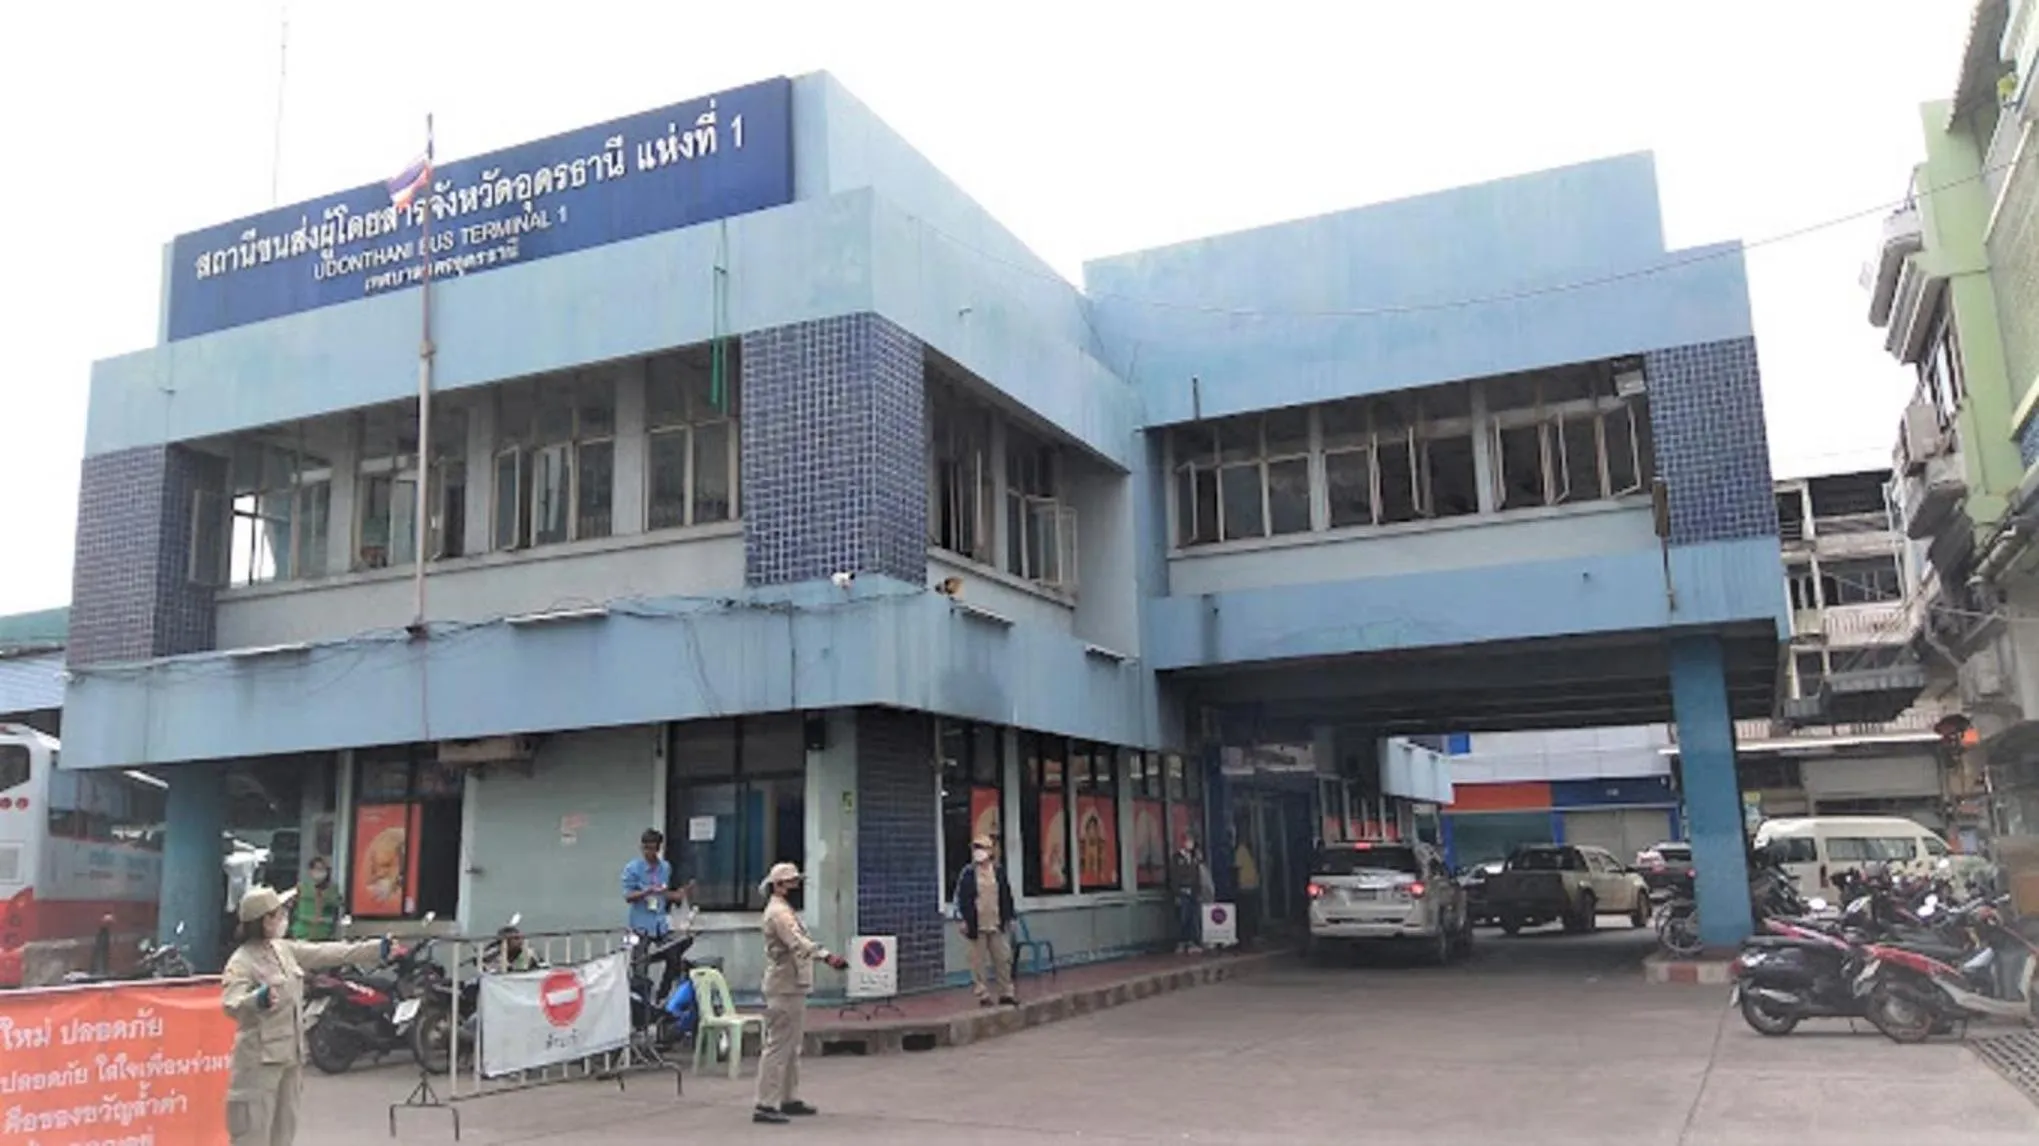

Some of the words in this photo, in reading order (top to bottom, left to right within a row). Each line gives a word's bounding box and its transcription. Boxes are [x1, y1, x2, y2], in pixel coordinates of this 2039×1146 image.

[636, 98, 718, 171] แห่งที่
[731, 114, 745, 148] 1
[313, 241, 414, 280] UDONTHANI
[460, 210, 552, 246] TERMINAL
[557, 205, 568, 223] 1
[0, 1015, 52, 1051] ใหม่
[59, 1007, 164, 1045] ปลอดภัย
[0, 1059, 88, 1094] ปลอดภัย
